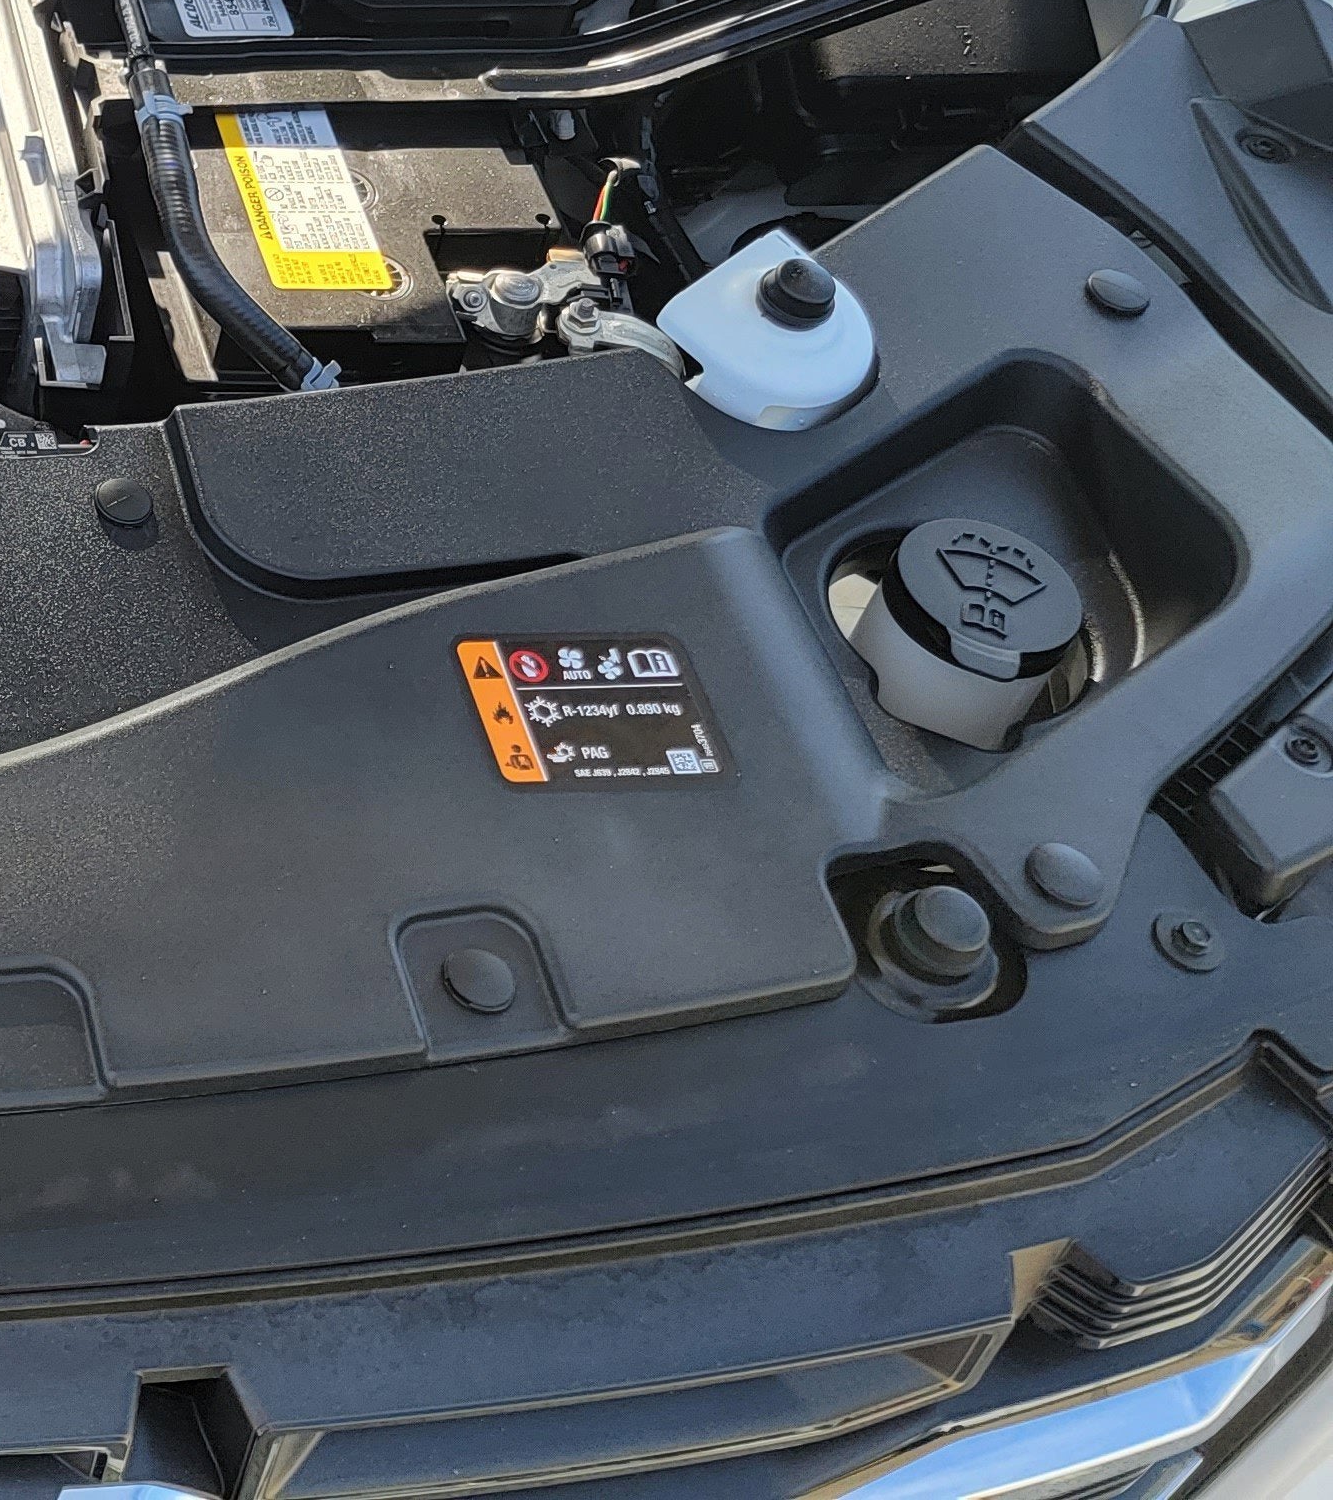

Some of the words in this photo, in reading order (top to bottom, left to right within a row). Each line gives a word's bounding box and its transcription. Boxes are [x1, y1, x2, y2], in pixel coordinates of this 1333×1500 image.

[233, 155, 256, 189] POISON
[248, 191, 270, 230] DANGER
[8, 438, 27, 448] CB
[563, 670, 592, 681] AUTO
[561, 704, 620, 718] R-1234yf
[625, 703, 662, 716] 0.890
[663, 702, 682, 717] kg
[581, 746, 610, 760] PAG
[573, 768, 592, 778] SAE
